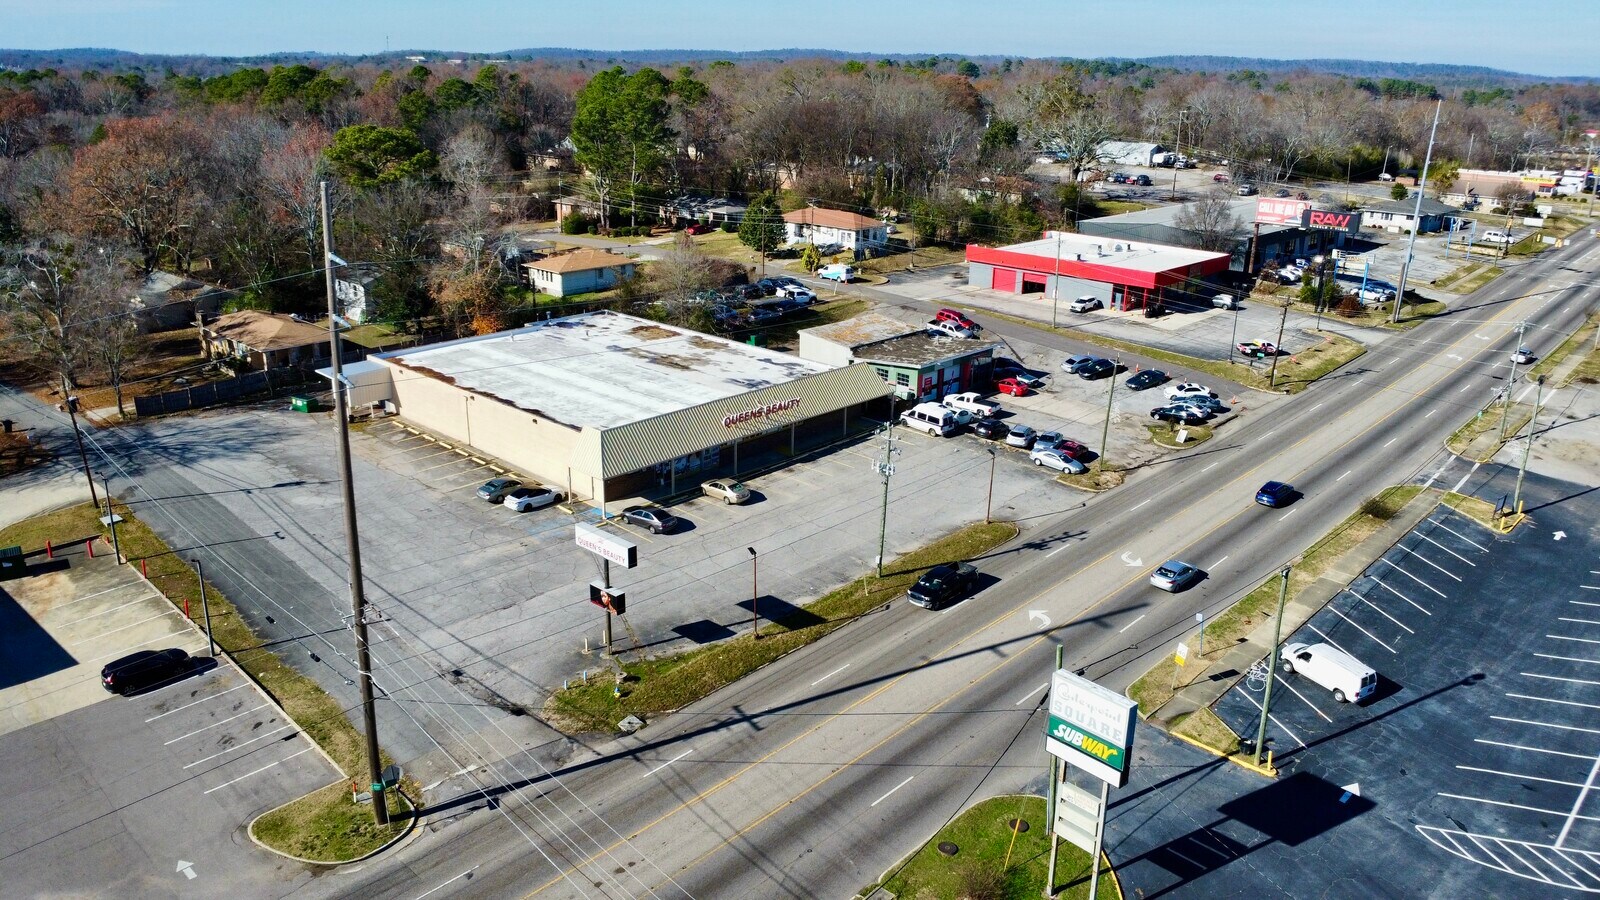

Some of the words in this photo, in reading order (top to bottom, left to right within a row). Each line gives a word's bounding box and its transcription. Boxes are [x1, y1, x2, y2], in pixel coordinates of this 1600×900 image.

[1309, 211, 1351, 228] RAW
[764, 397, 801, 416] BEAUTY
[577, 537, 602, 553] QUEEN'S
[602, 548, 626, 564] BEAUTY
[1054, 700, 1122, 742] SQUARE
[1053, 724, 1118, 761] SUBWAY
